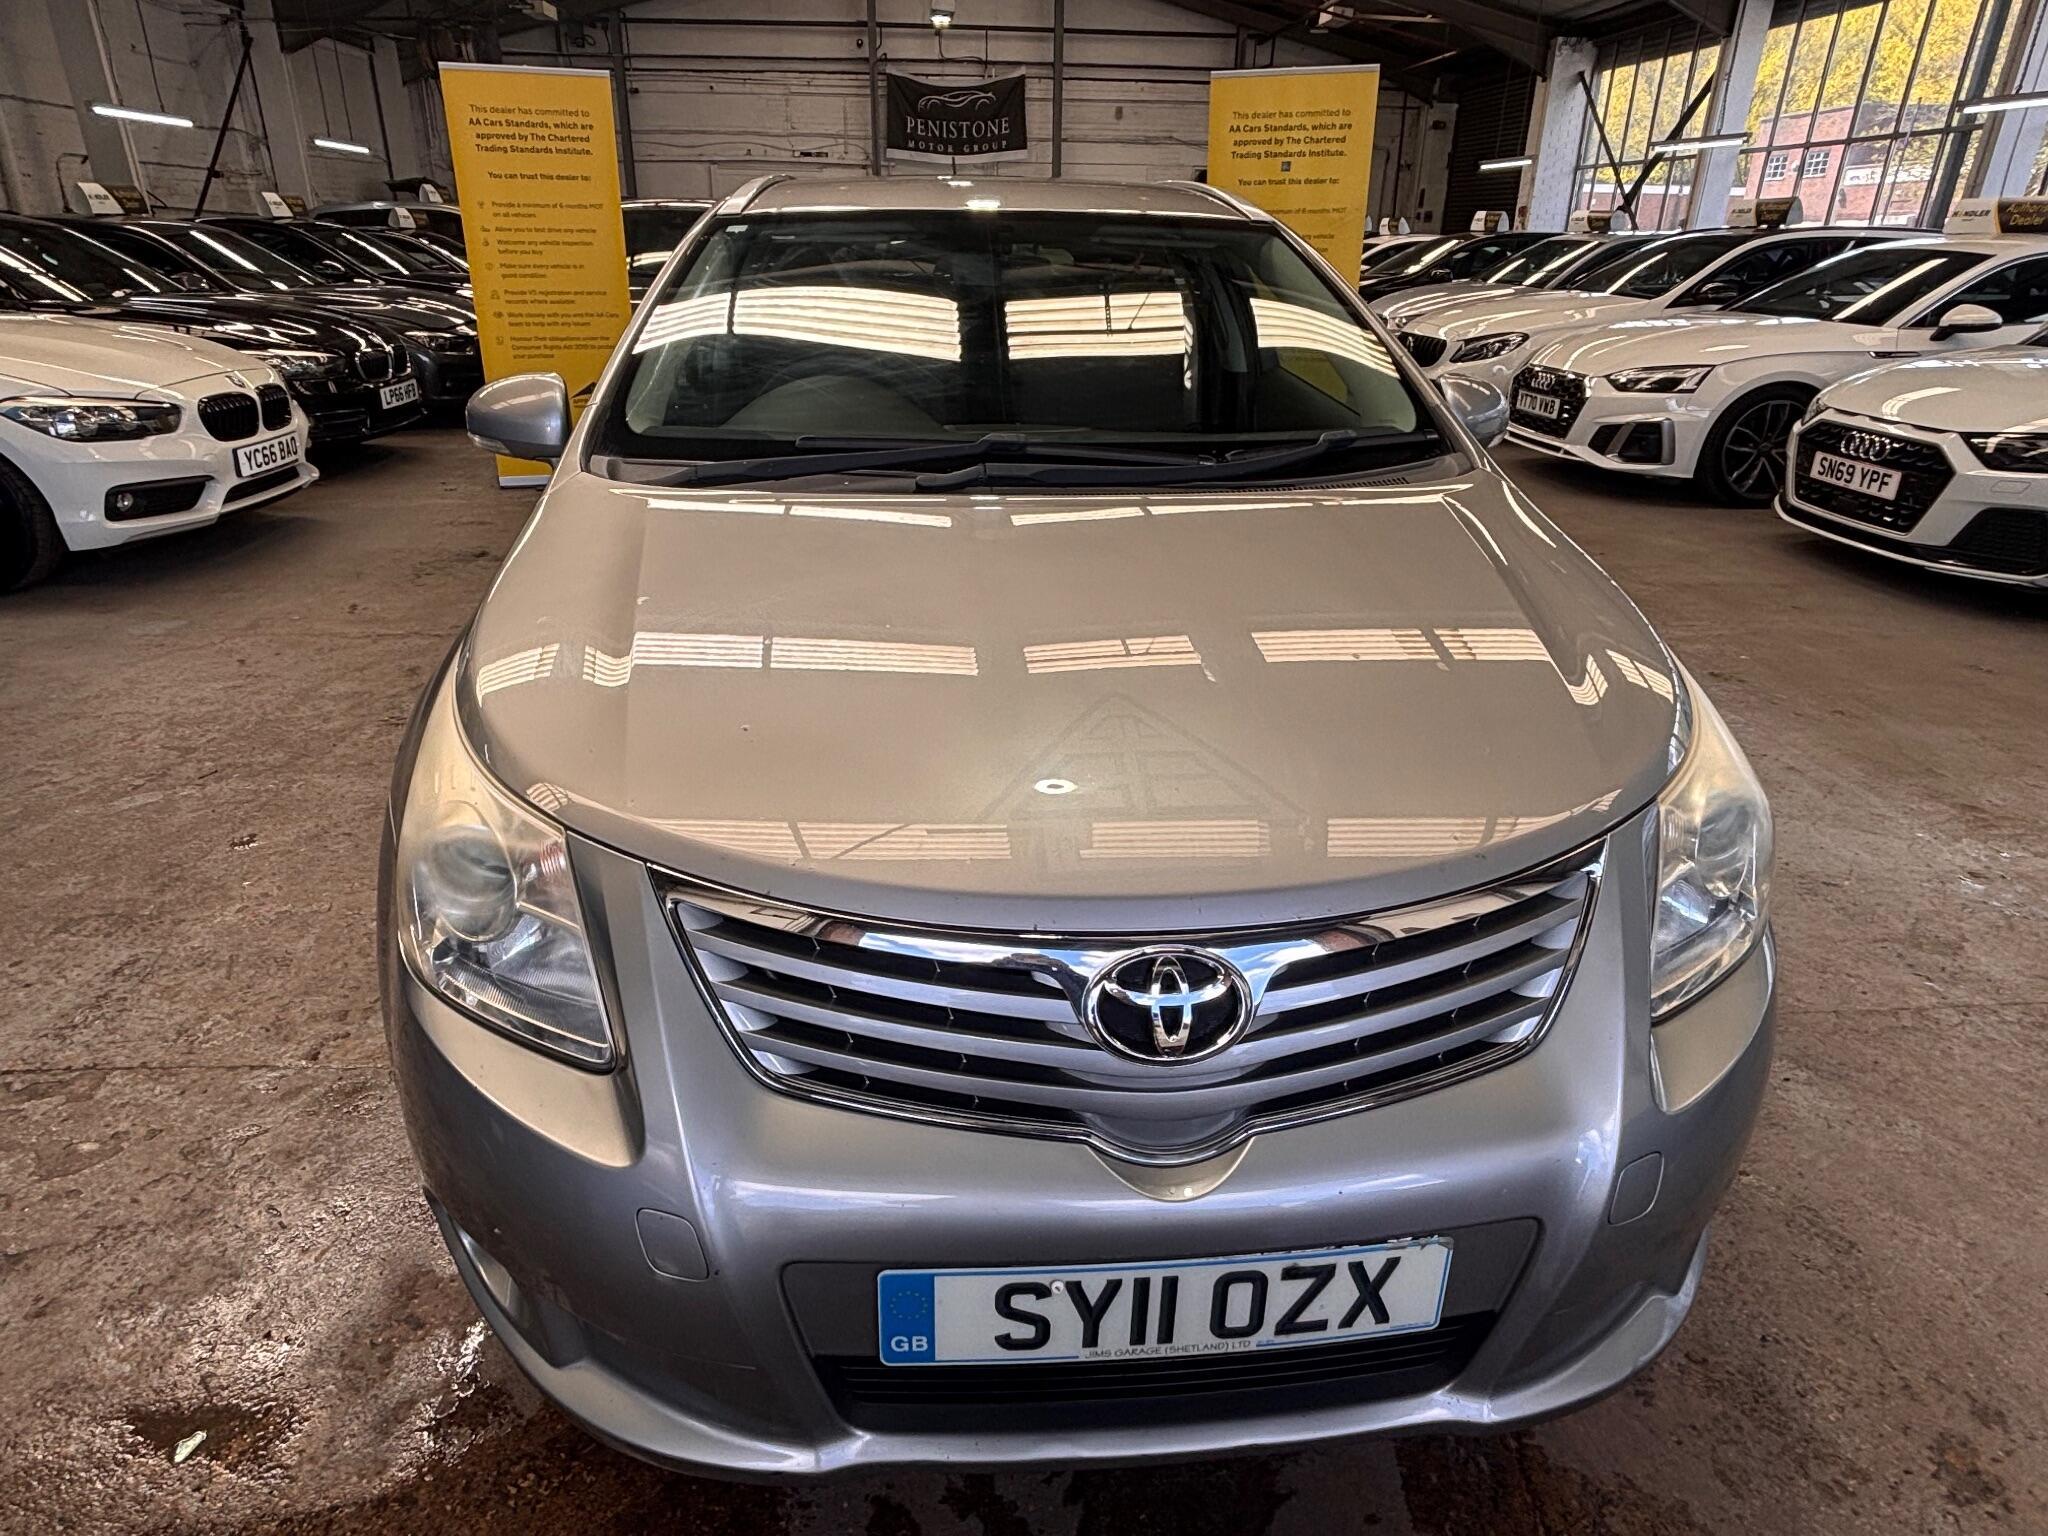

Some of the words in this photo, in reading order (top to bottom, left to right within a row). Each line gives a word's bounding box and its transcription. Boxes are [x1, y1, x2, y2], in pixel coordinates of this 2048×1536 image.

[470, 104, 487, 113] This
[490, 106, 515, 114] dealer
[518, 106, 532, 114] has
[535, 108, 579, 116] committed
[581, 109, 590, 117] to
[1279, 110, 1293, 118] has
[1295, 109, 1340, 117] committed
[469, 118, 481, 126] AA
[505, 119, 551, 129] Standards,
[553, 121, 578, 129] which
[906, 116, 1010, 138] PENISTONE
[1264, 123, 1309, 132] Standards,
[1311, 122, 1336, 130] which
[518, 133, 528, 141] by
[530, 133, 546, 141] The
[548, 134, 590, 143] Chartered
[1233, 138, 1272, 147] approved
[1274, 137, 1284, 146] by
[1286, 136, 1301, 144] The
[1304, 136, 1346, 144] Chartered
[476, 144, 508, 153] Trading
[510, 145, 553, 154] Standards
[555, 146, 593, 155] Institute.
[908, 140, 954, 152] MOTOR
[963, 140, 1007, 152] GROUP
[1231, 151, 1262, 159] Trading
[1264, 150, 1306, 158] Standards
[1309, 149, 1347, 157] Institute.
[488, 171, 502, 179] You
[2010, 215, 2045, 225] Dealer
[244, 444, 277, 470] YC66
[278, 436, 297, 460] BAO
[1818, 457, 1855, 483] SN69
[1859, 468, 1892, 492] YPF
[1209, 1257, 1401, 1340] OZX
[891, 1336, 928, 1352] GB
[1085, 1351, 1112, 1359] JIMS
[1114, 1347, 1161, 1357] GARAGE
[1165, 1342, 1228, 1354] (SHETLAND)
[1232, 1341, 1250, 1349] LTD
